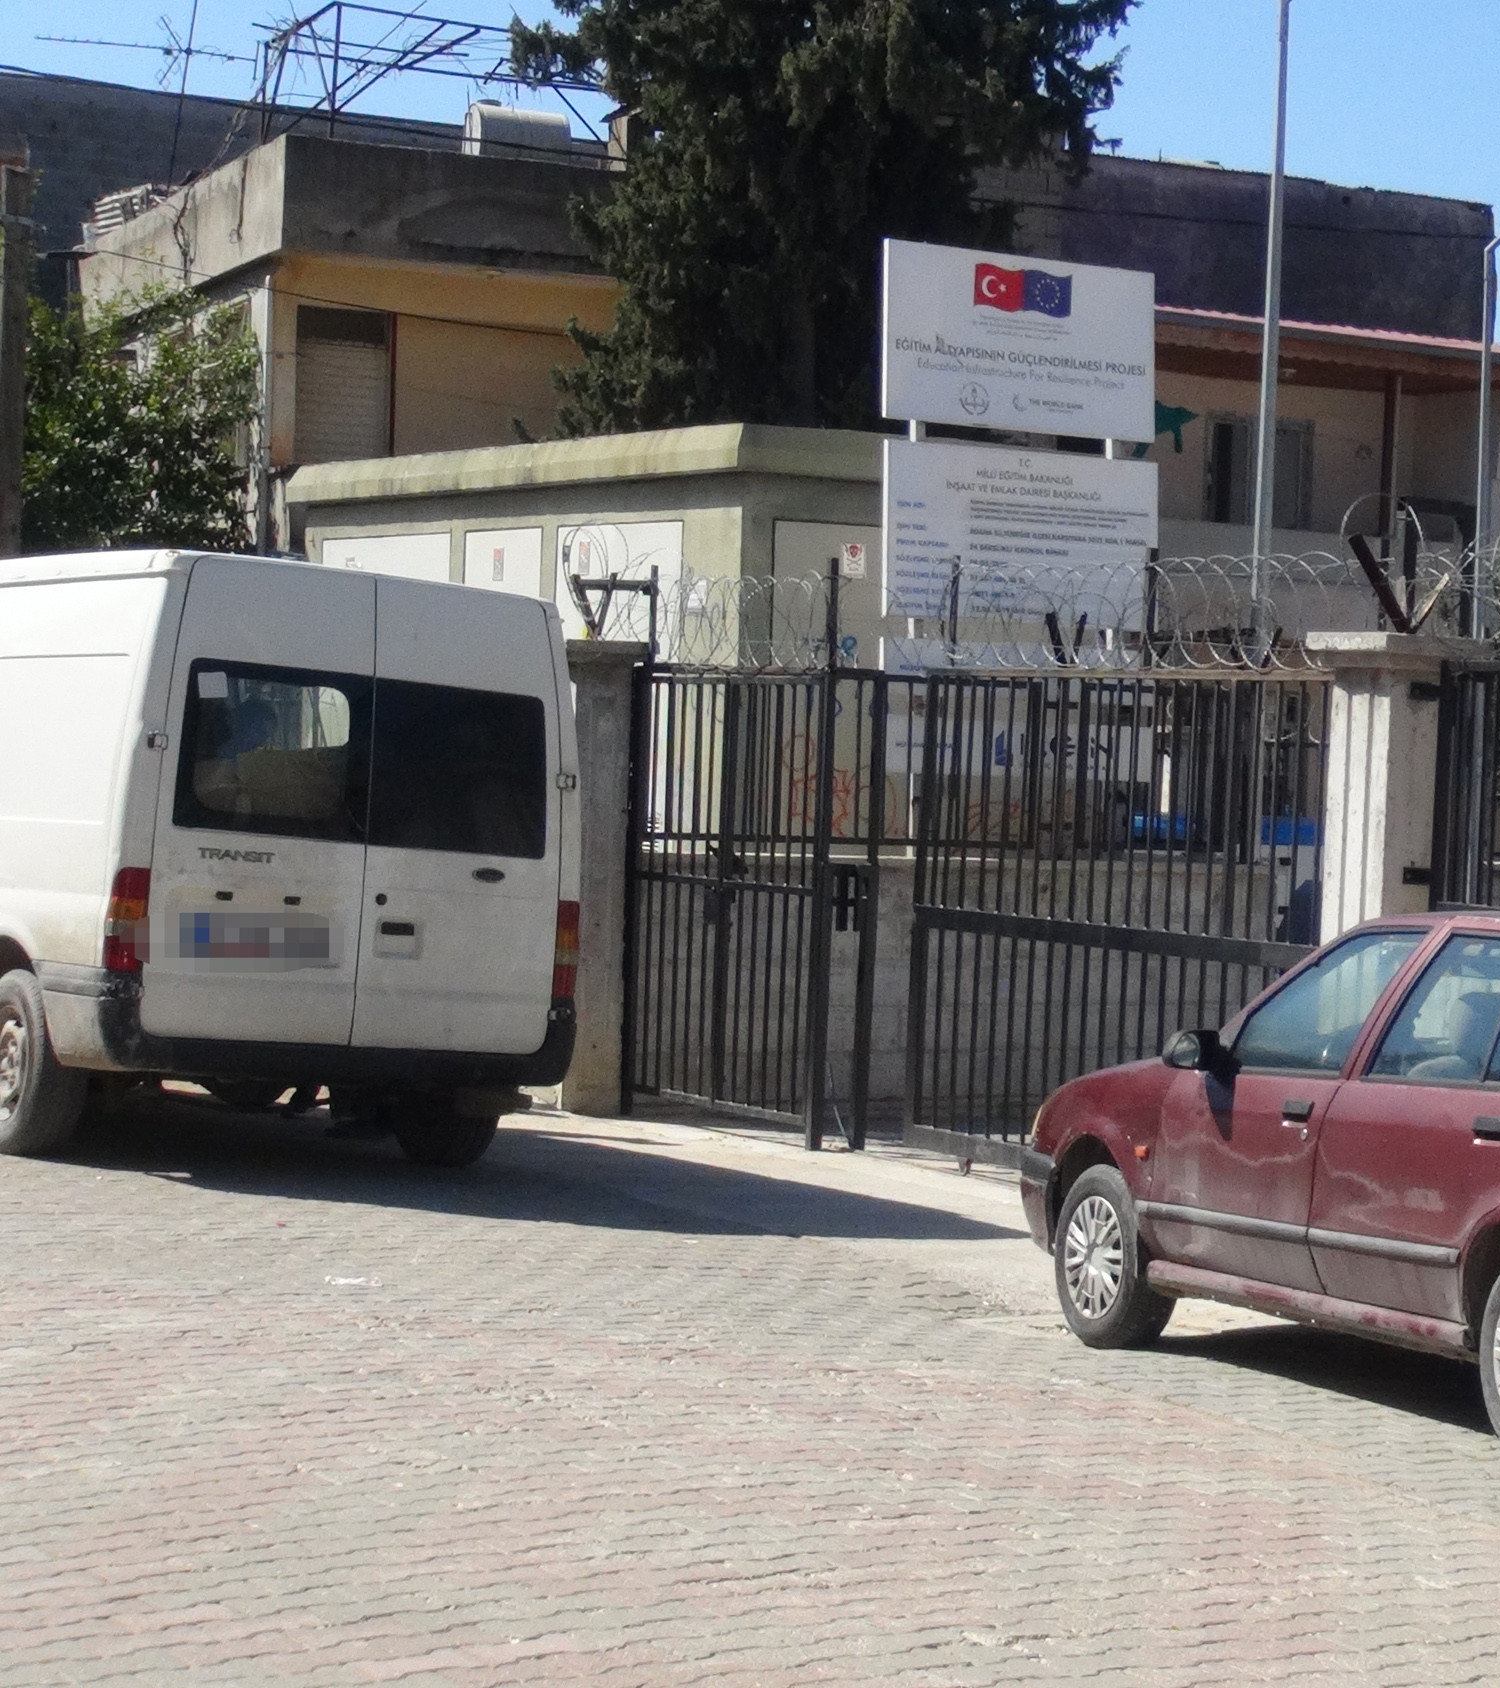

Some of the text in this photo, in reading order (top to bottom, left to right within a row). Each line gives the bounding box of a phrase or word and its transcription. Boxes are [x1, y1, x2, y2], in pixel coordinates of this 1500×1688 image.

[895, 336, 932, 353] EĞİTİM
[1008, 350, 1102, 372] GÜÇLENDİRİLMESİ
[1106, 362, 1146, 376] PROJESİ
[1029, 369, 1044, 381] For
[198, 846, 275, 864] TRANSIT
